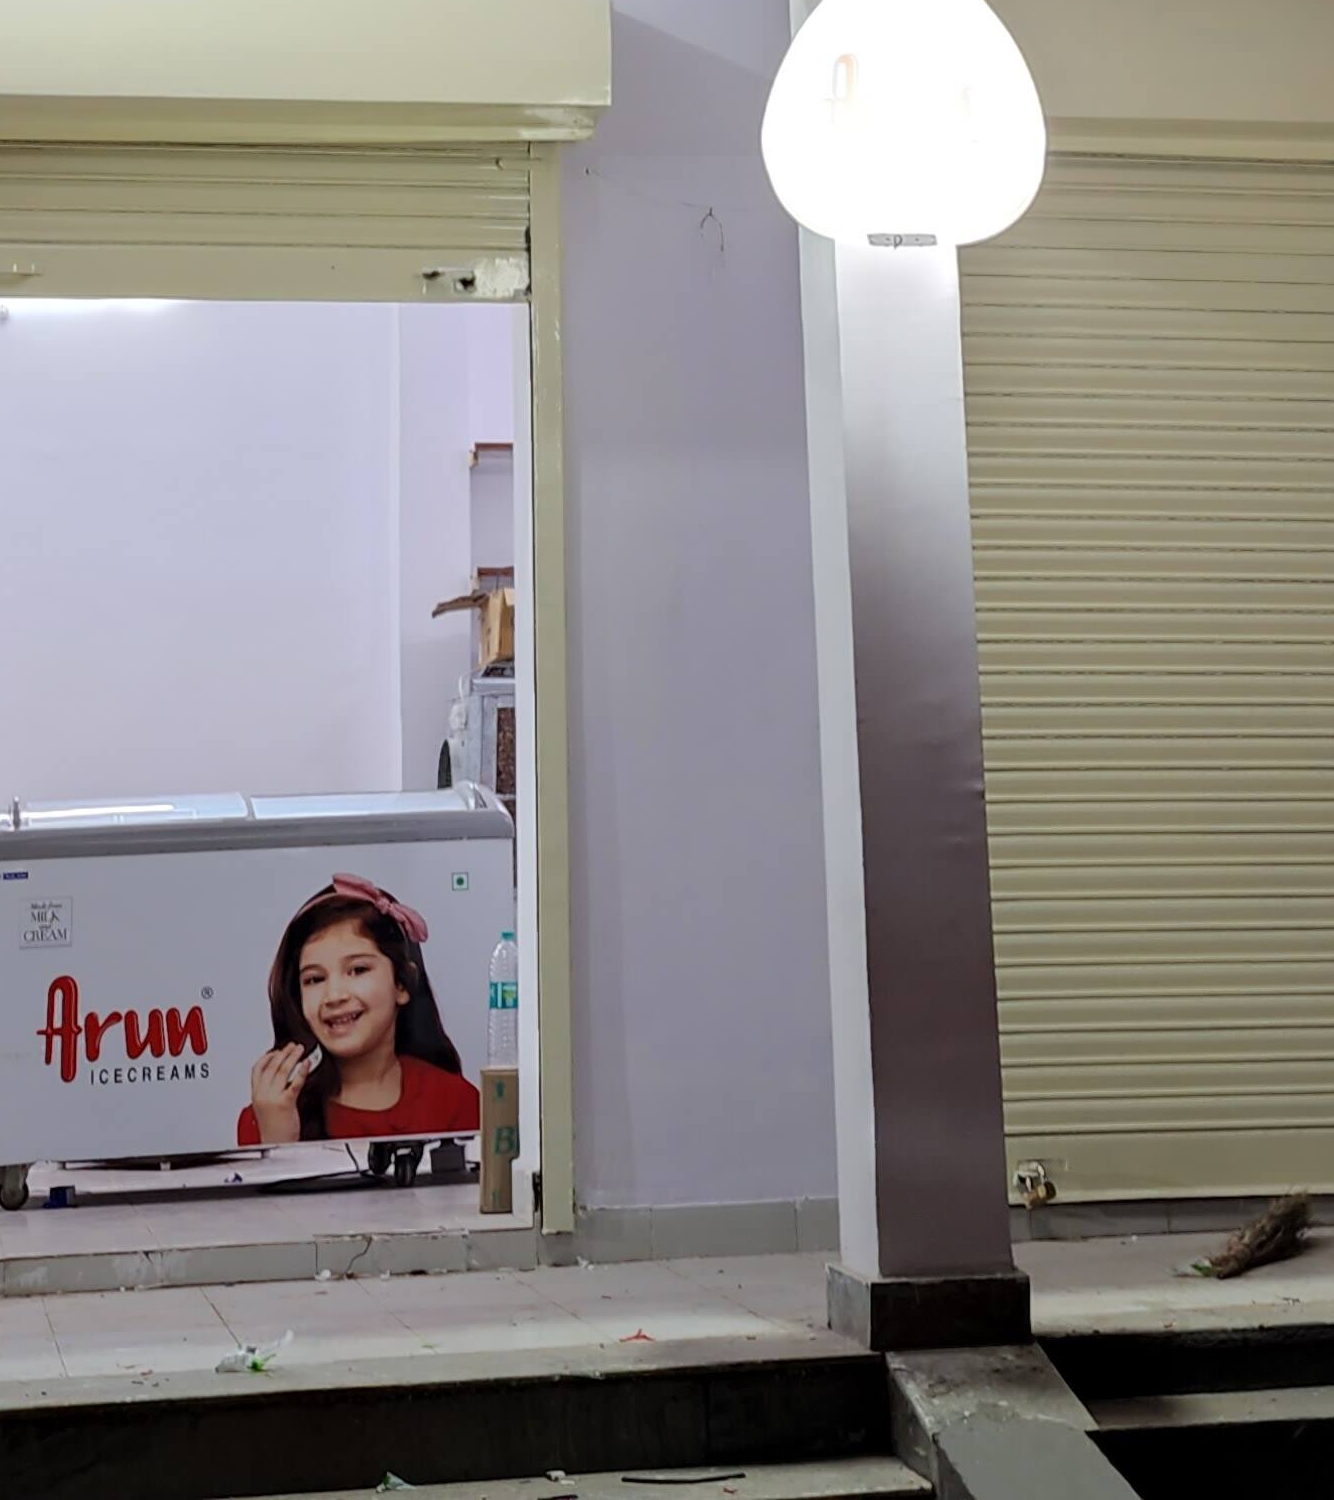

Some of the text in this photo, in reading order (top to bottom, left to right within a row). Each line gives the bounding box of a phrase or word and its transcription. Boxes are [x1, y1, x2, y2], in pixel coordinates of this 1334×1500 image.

[31, 910, 60, 923] MILK
[23, 928, 68, 942] CREAM
[36, 975, 208, 1084] Arun
[90, 1061, 210, 1086] ICECREAMS
